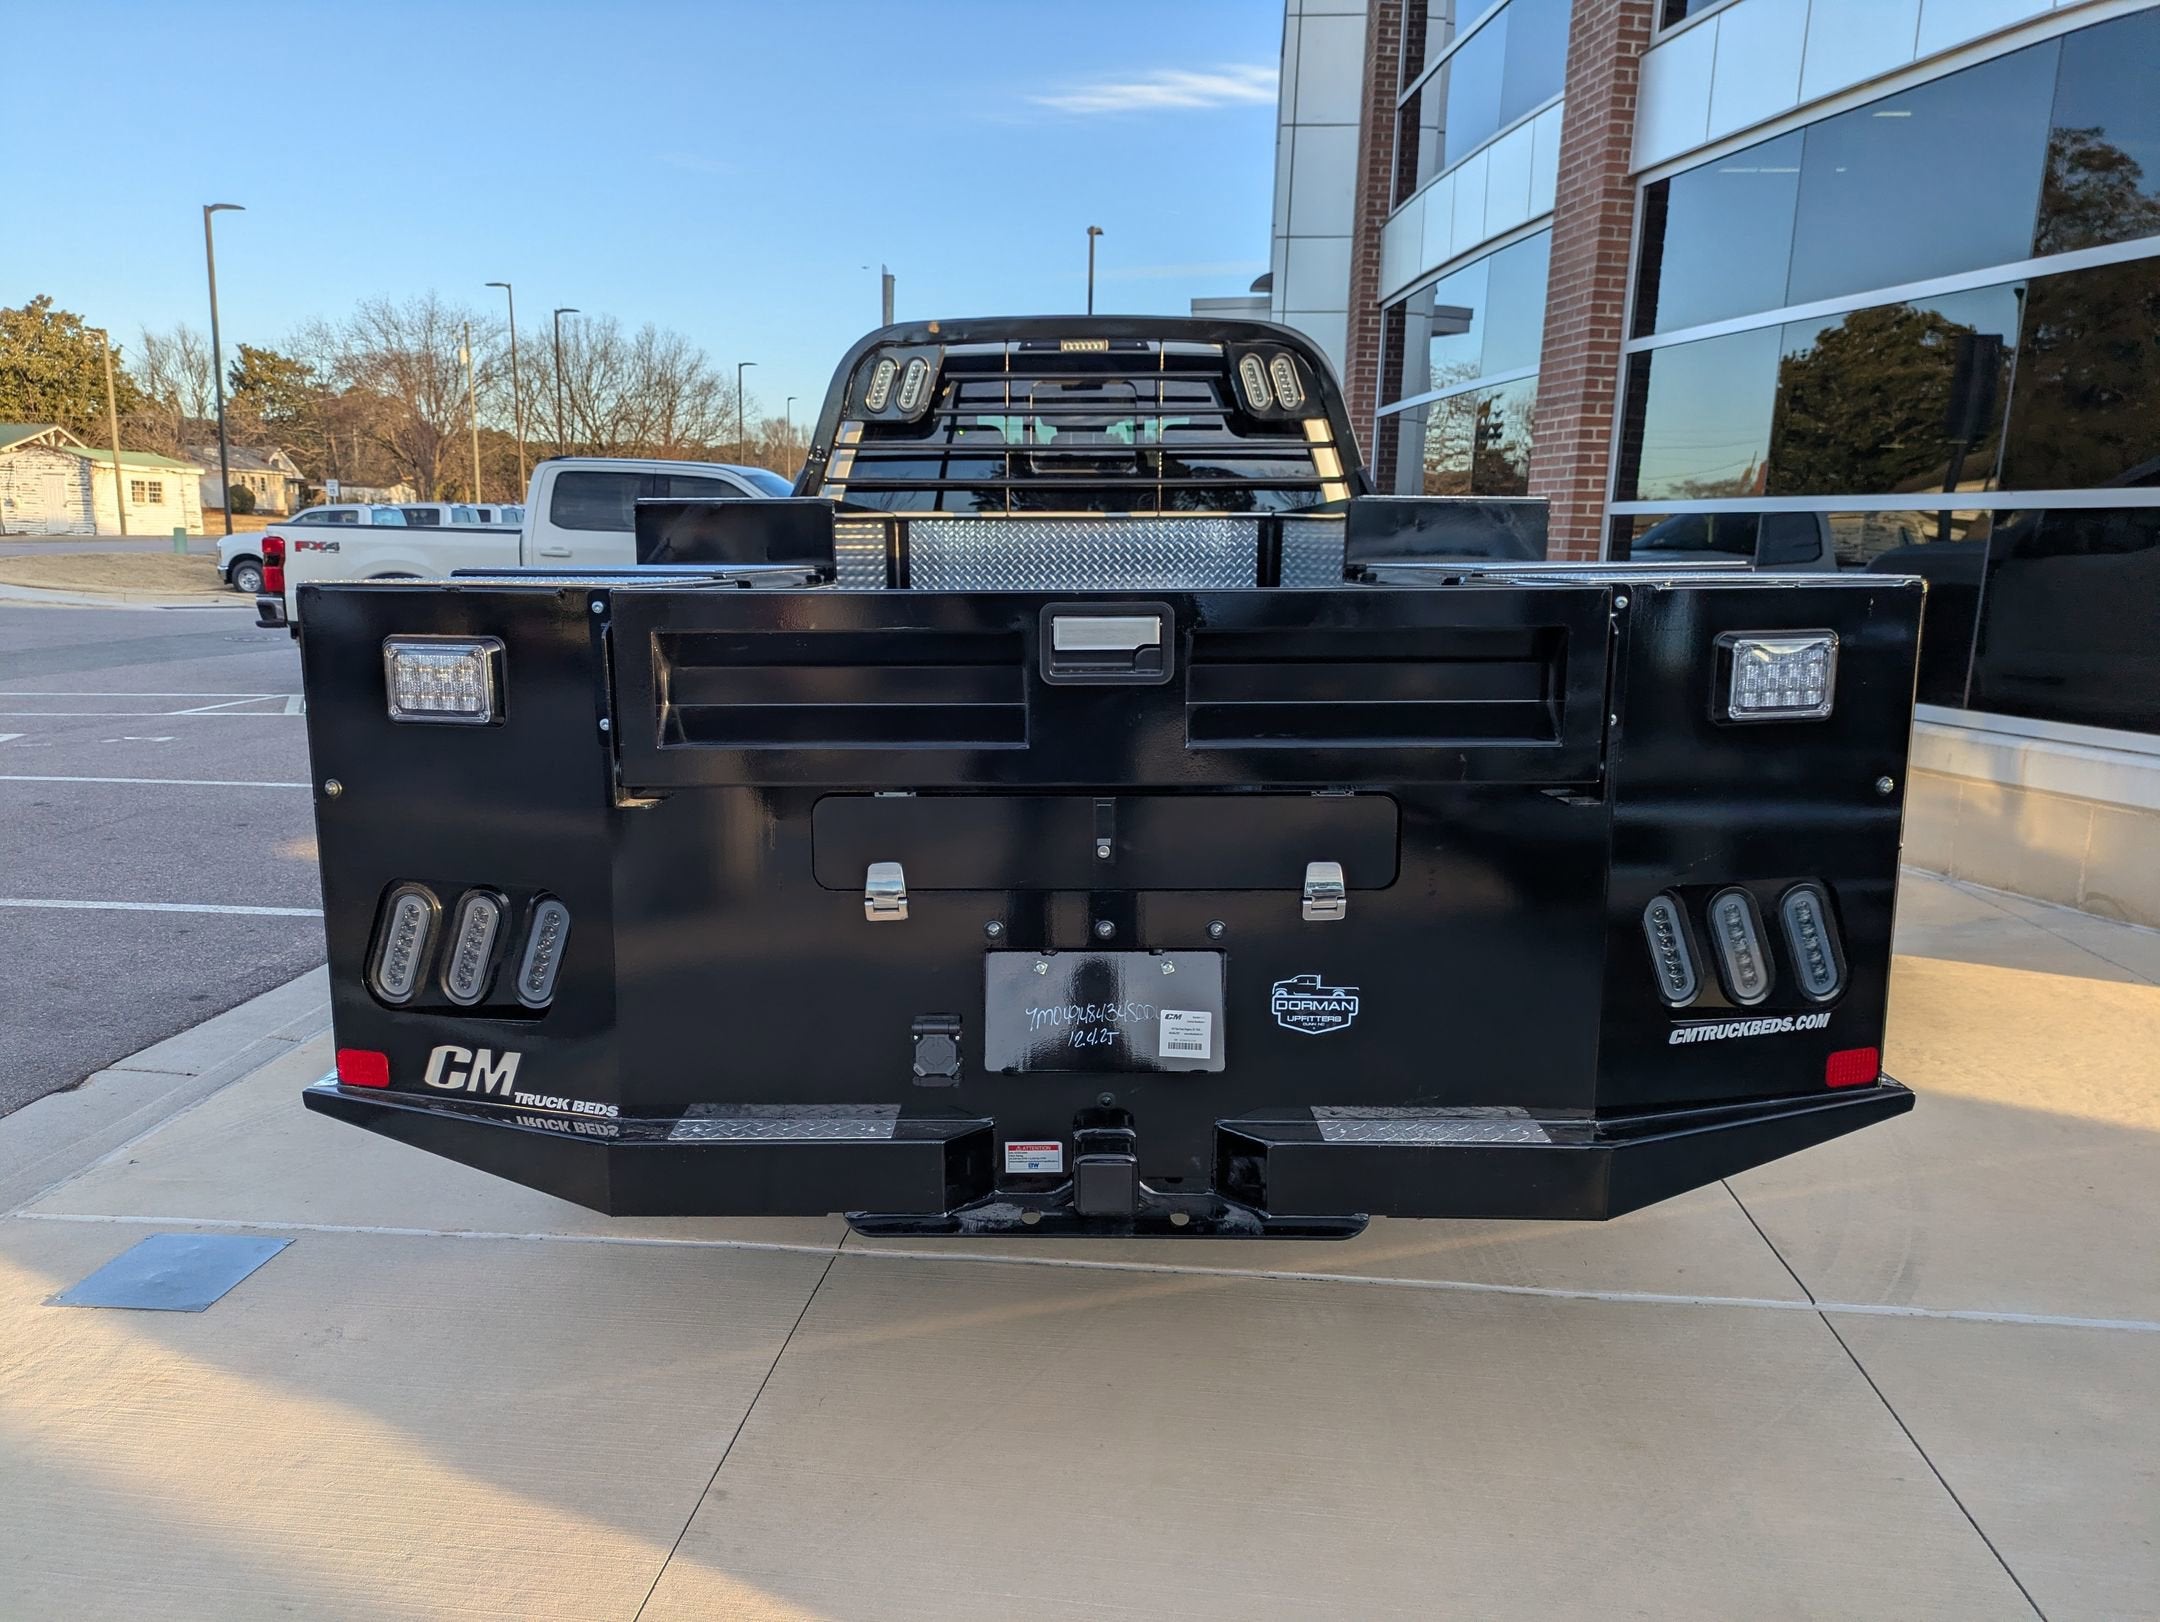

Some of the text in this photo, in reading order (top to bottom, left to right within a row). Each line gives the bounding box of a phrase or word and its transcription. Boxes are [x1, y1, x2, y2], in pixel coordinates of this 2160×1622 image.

[295, 541, 340, 553] FX4
[1276, 1000, 1354, 1011] DORMAN
[1164, 1013, 1183, 1021] CM
[1286, 1015, 1342, 1023] UPFITTERS
[1668, 1013, 1832, 1045] CMTRUCKBEDS.COM
[424, 1045, 522, 1096] CM
[514, 1092, 619, 1117] TRUCK BEDS
